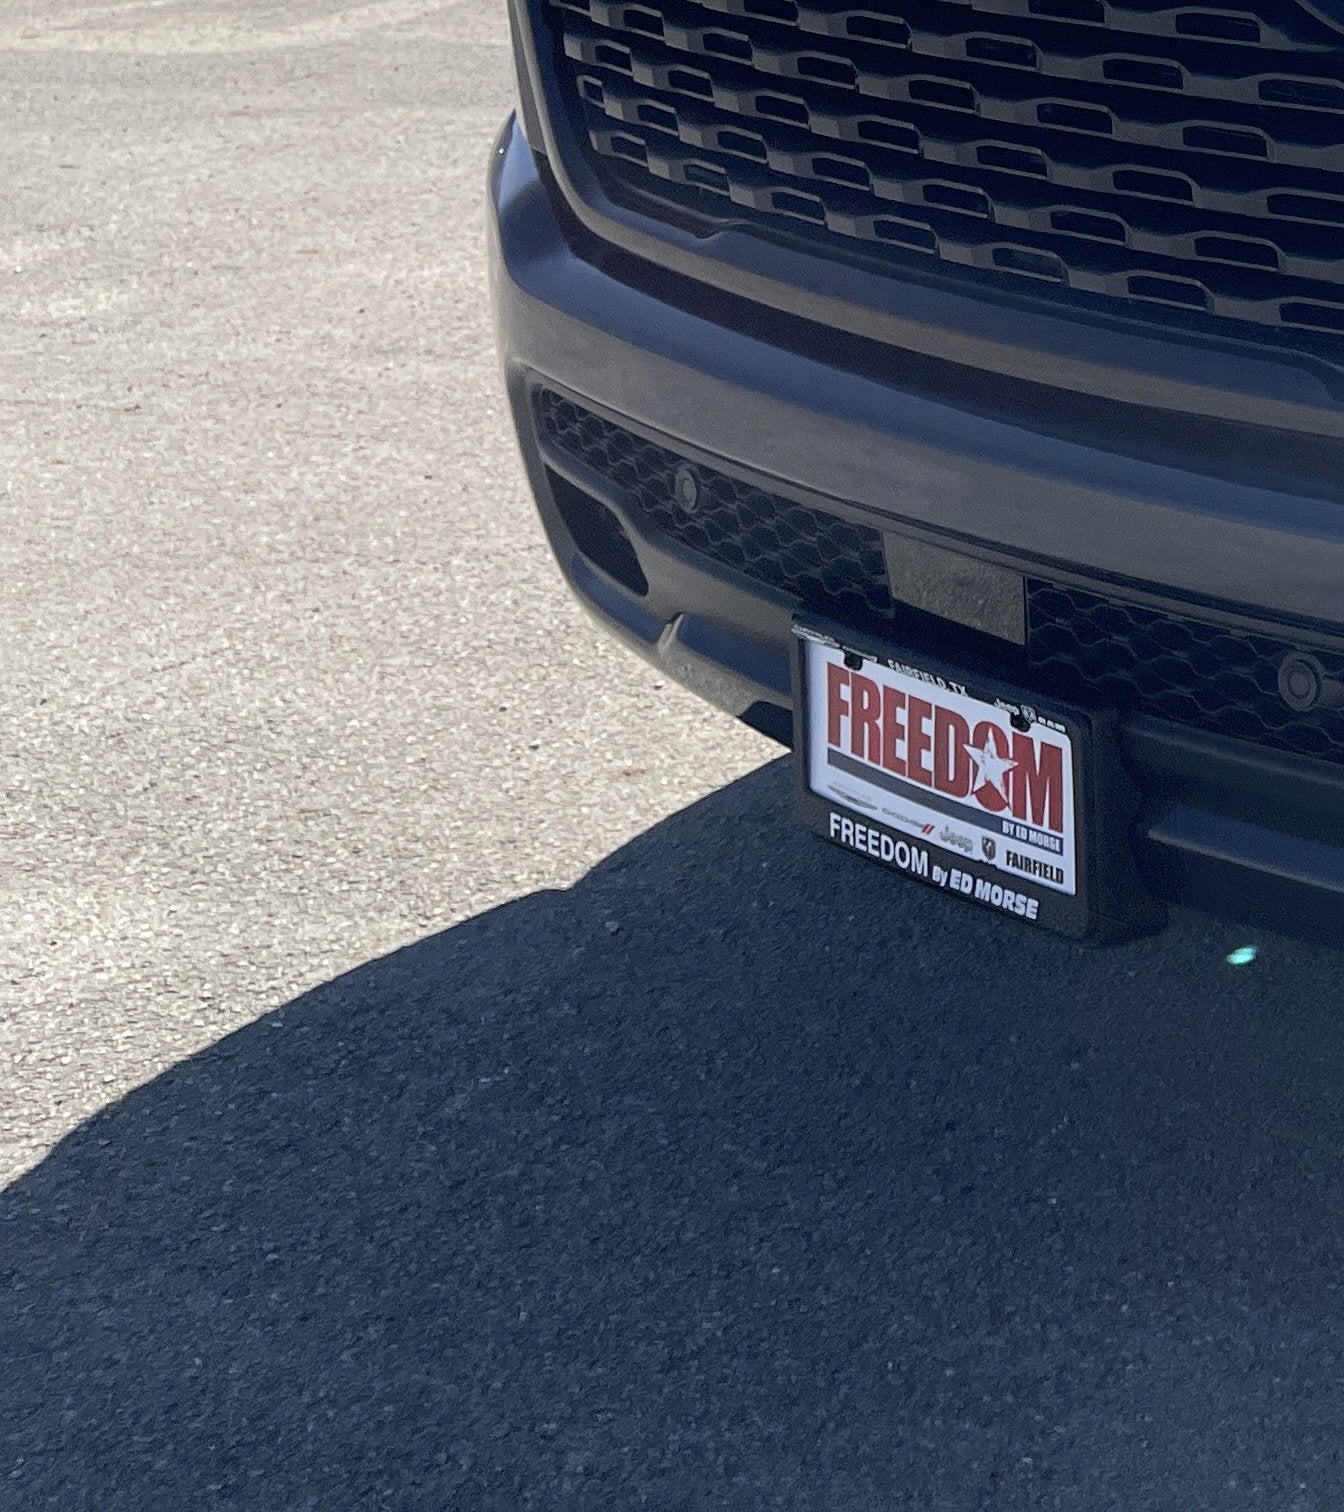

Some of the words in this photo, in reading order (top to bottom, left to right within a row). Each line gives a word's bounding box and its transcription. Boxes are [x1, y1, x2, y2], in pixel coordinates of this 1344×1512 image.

[827, 661, 1064, 833] FREEDOM
[829, 812, 929, 878] FREEDOM
[949, 868, 974, 895] ED
[974, 878, 1039, 920] MORSE
[1002, 820, 1015, 836] BY
[1016, 825, 1028, 841] ED
[1028, 829, 1061, 852] MORSE
[1006, 849, 1064, 885] FAIRFIELD
